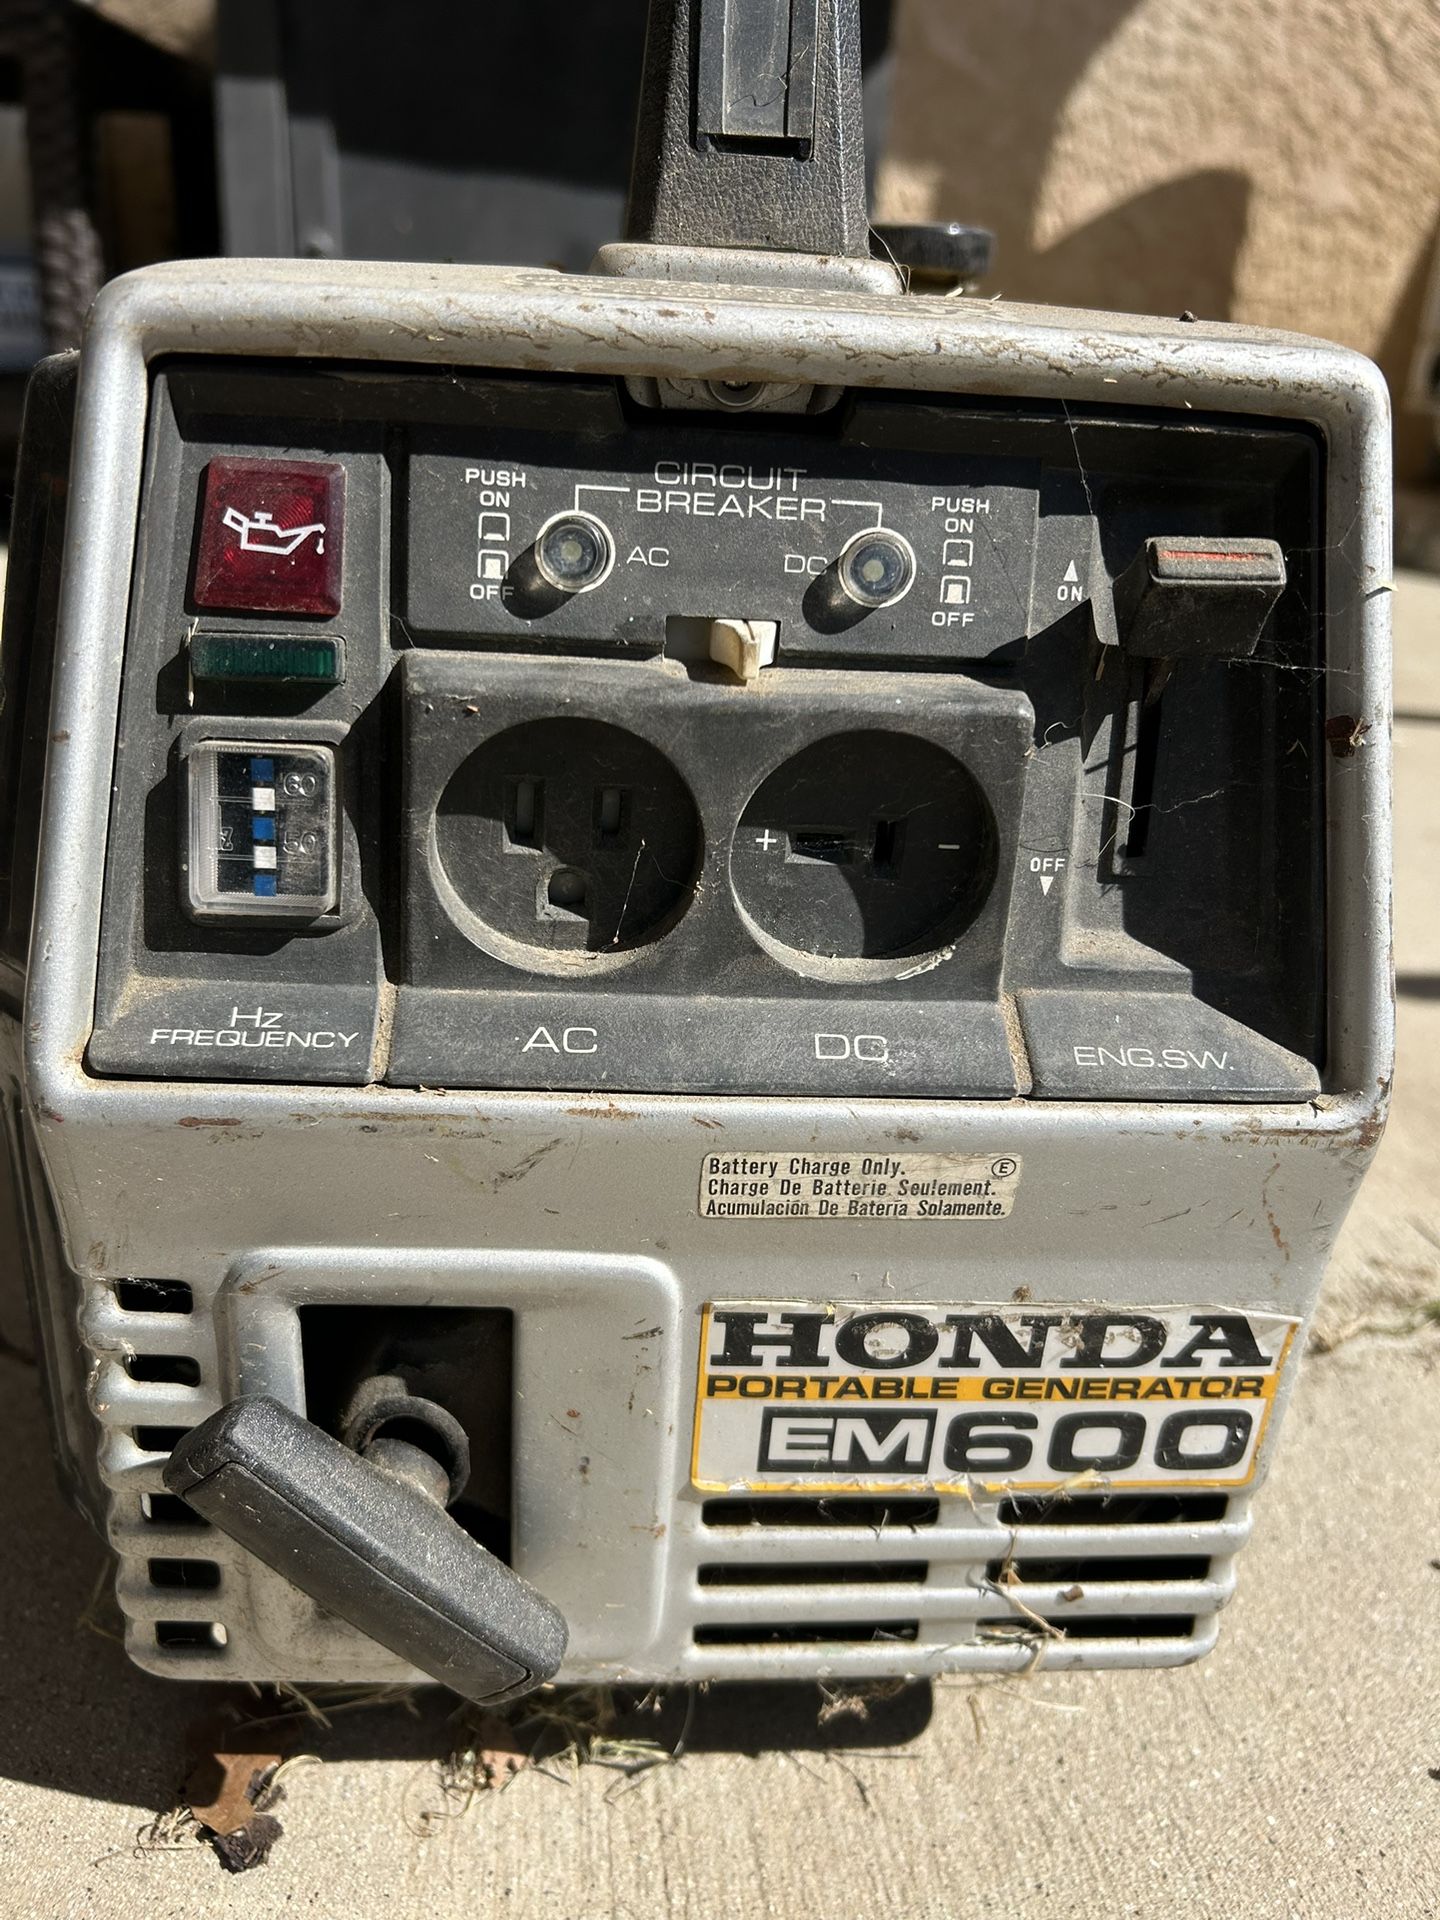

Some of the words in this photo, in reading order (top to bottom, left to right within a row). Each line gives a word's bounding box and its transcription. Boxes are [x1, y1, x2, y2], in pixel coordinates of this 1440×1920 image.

[465, 468, 526, 488] PUSH
[654, 461, 806, 492] CIRCUIT
[479, 490, 510, 508] ON
[636, 490, 826, 522] BREAKER
[931, 497, 990, 514] PUSH
[944, 518, 974, 534] ON
[626, 548, 669, 568] AC
[783, 554, 827, 575] DC
[469, 584, 514, 601] OFF
[1056, 586, 1083, 602] ON
[931, 611, 975, 628] OFF
[1030, 858, 1065, 872] OFF
[230, 1006, 282, 1027] Hz
[150, 1030, 359, 1049] FREQUENCY
[522, 1027, 598, 1054] AC
[814, 1033, 888, 1062] DC
[709, 1157, 778, 1177] Battery
[789, 1158, 851, 1176] Charge
[861, 1158, 906, 1178] Only.
[708, 1179, 769, 1196] Charge
[780, 1180, 801, 1196] De
[812, 1180, 887, 1197] Batterie
[899, 1179, 996, 1197] Seulement.
[706, 1199, 809, 1216] Acumulación
[818, 1200, 839, 1216] De
[917, 1201, 1006, 1217] Solamente.
[710, 1312, 1273, 1369] HONDA
[707, 1375, 960, 1399] PORTABLE
[982, 1376, 1264, 1400] GENERATOR
[757, 1407, 1253, 1474] EM600
